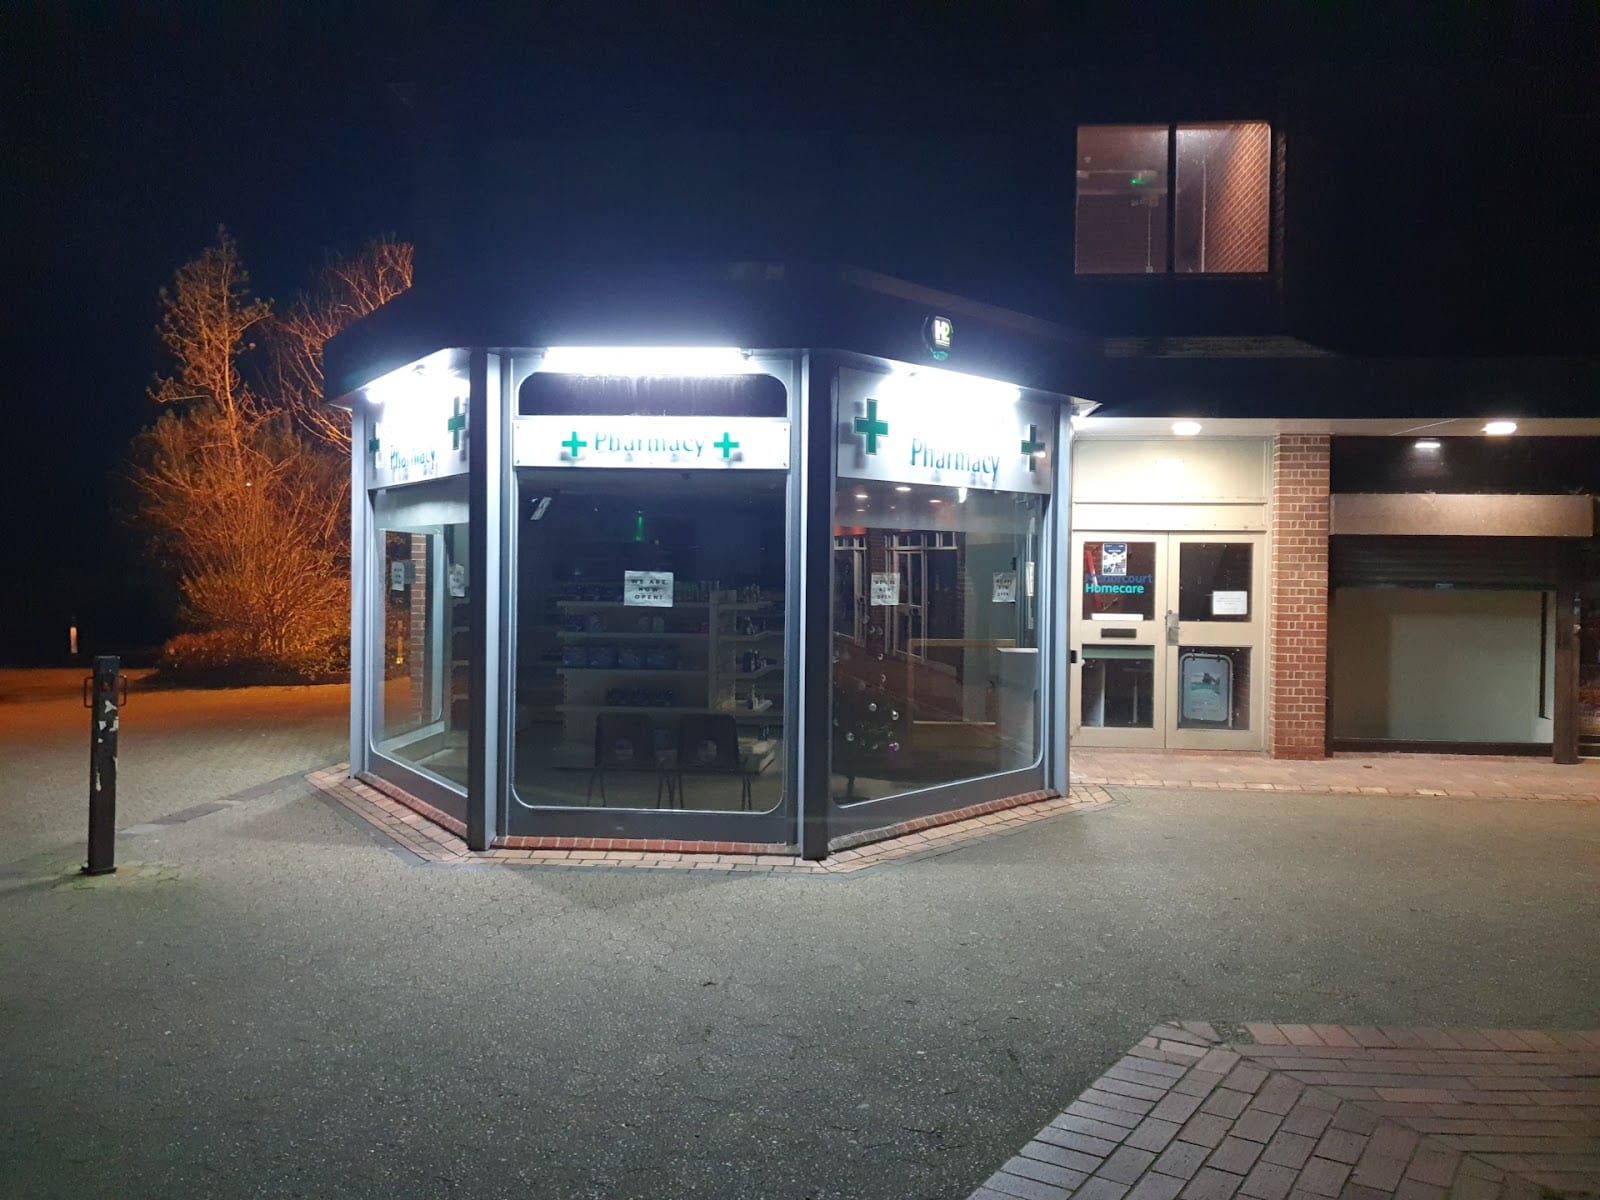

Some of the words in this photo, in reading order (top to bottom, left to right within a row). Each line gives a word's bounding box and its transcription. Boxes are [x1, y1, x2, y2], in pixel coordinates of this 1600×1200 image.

[595, 432, 704, 457] Pharmacy
[911, 438, 999, 481] Pharmacy
[1085, 583, 1145, 593] Homecare
